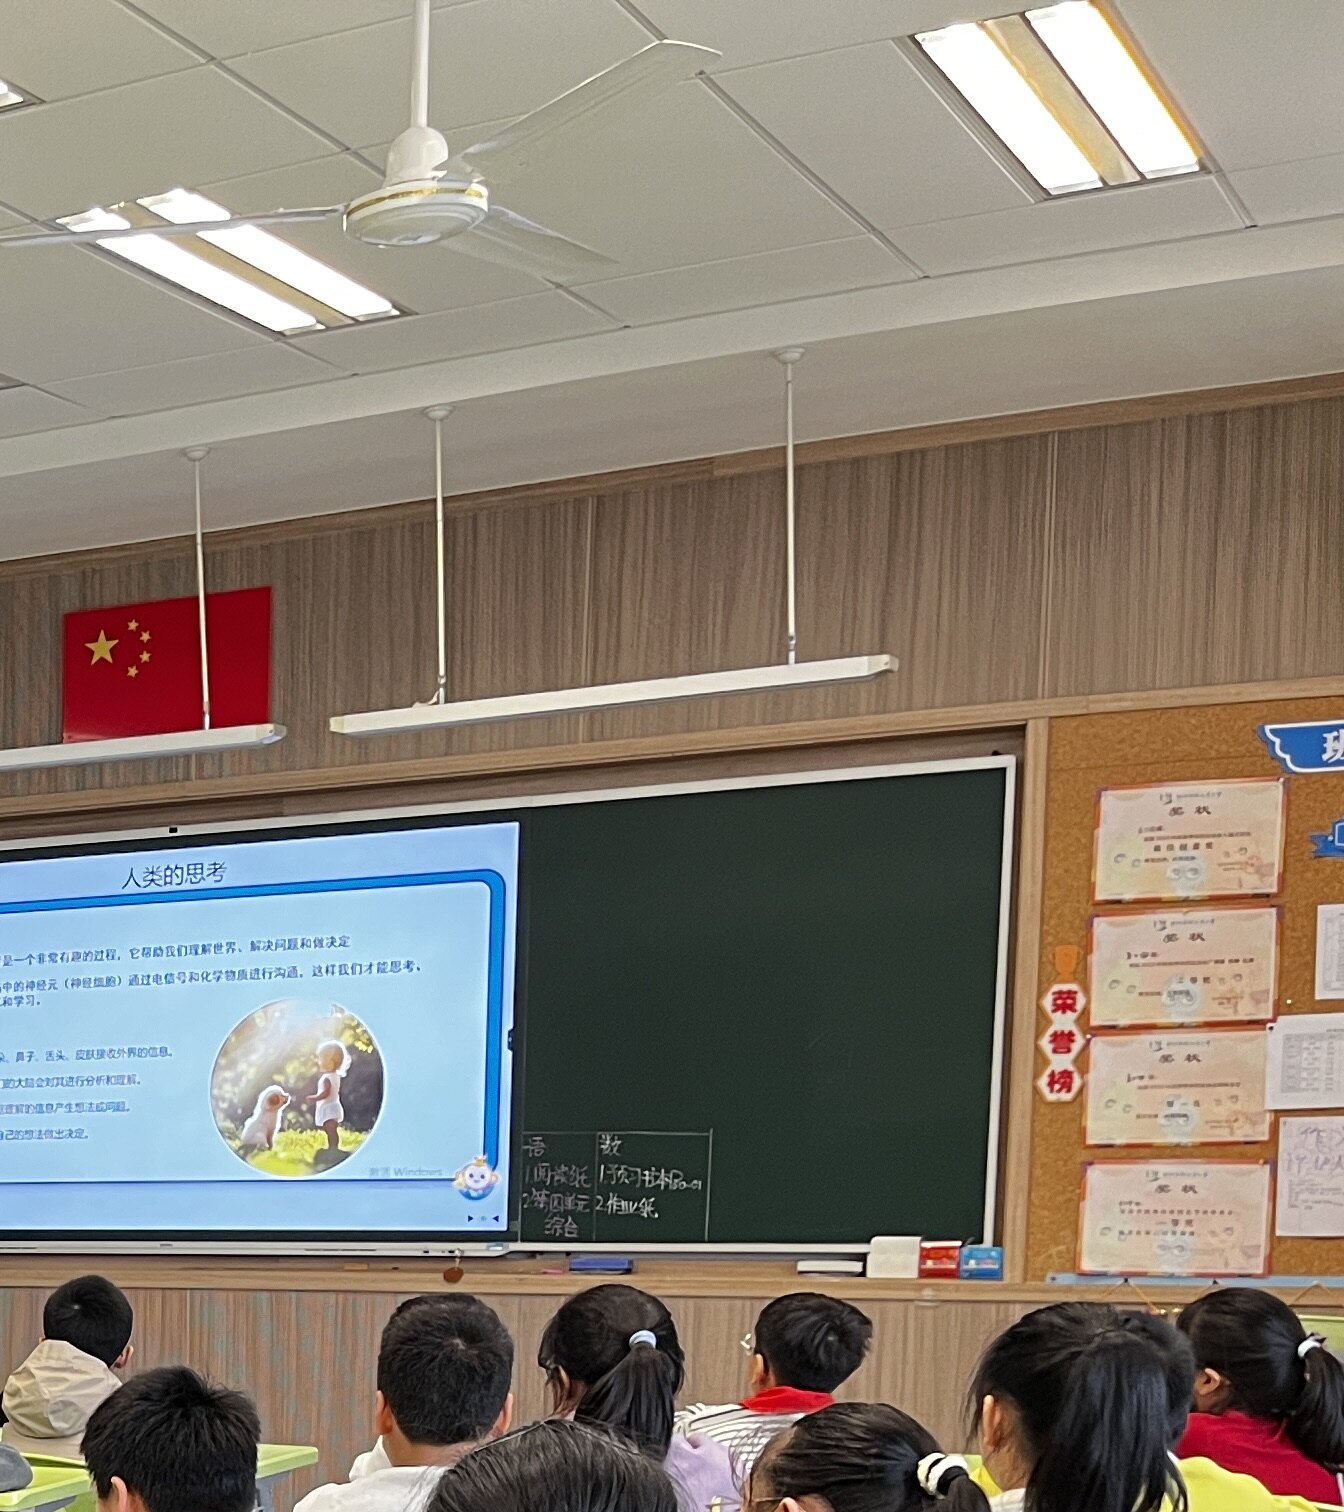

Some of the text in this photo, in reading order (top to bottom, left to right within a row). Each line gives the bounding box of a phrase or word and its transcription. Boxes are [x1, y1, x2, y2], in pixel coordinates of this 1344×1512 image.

[121, 861, 227, 890] 人类的思考
[522, 1136, 546, 1158] 语
[599, 1133, 622, 1156] 数
[393, 1166, 443, 1177] Windows
[544, 1212, 579, 1238] 综合
